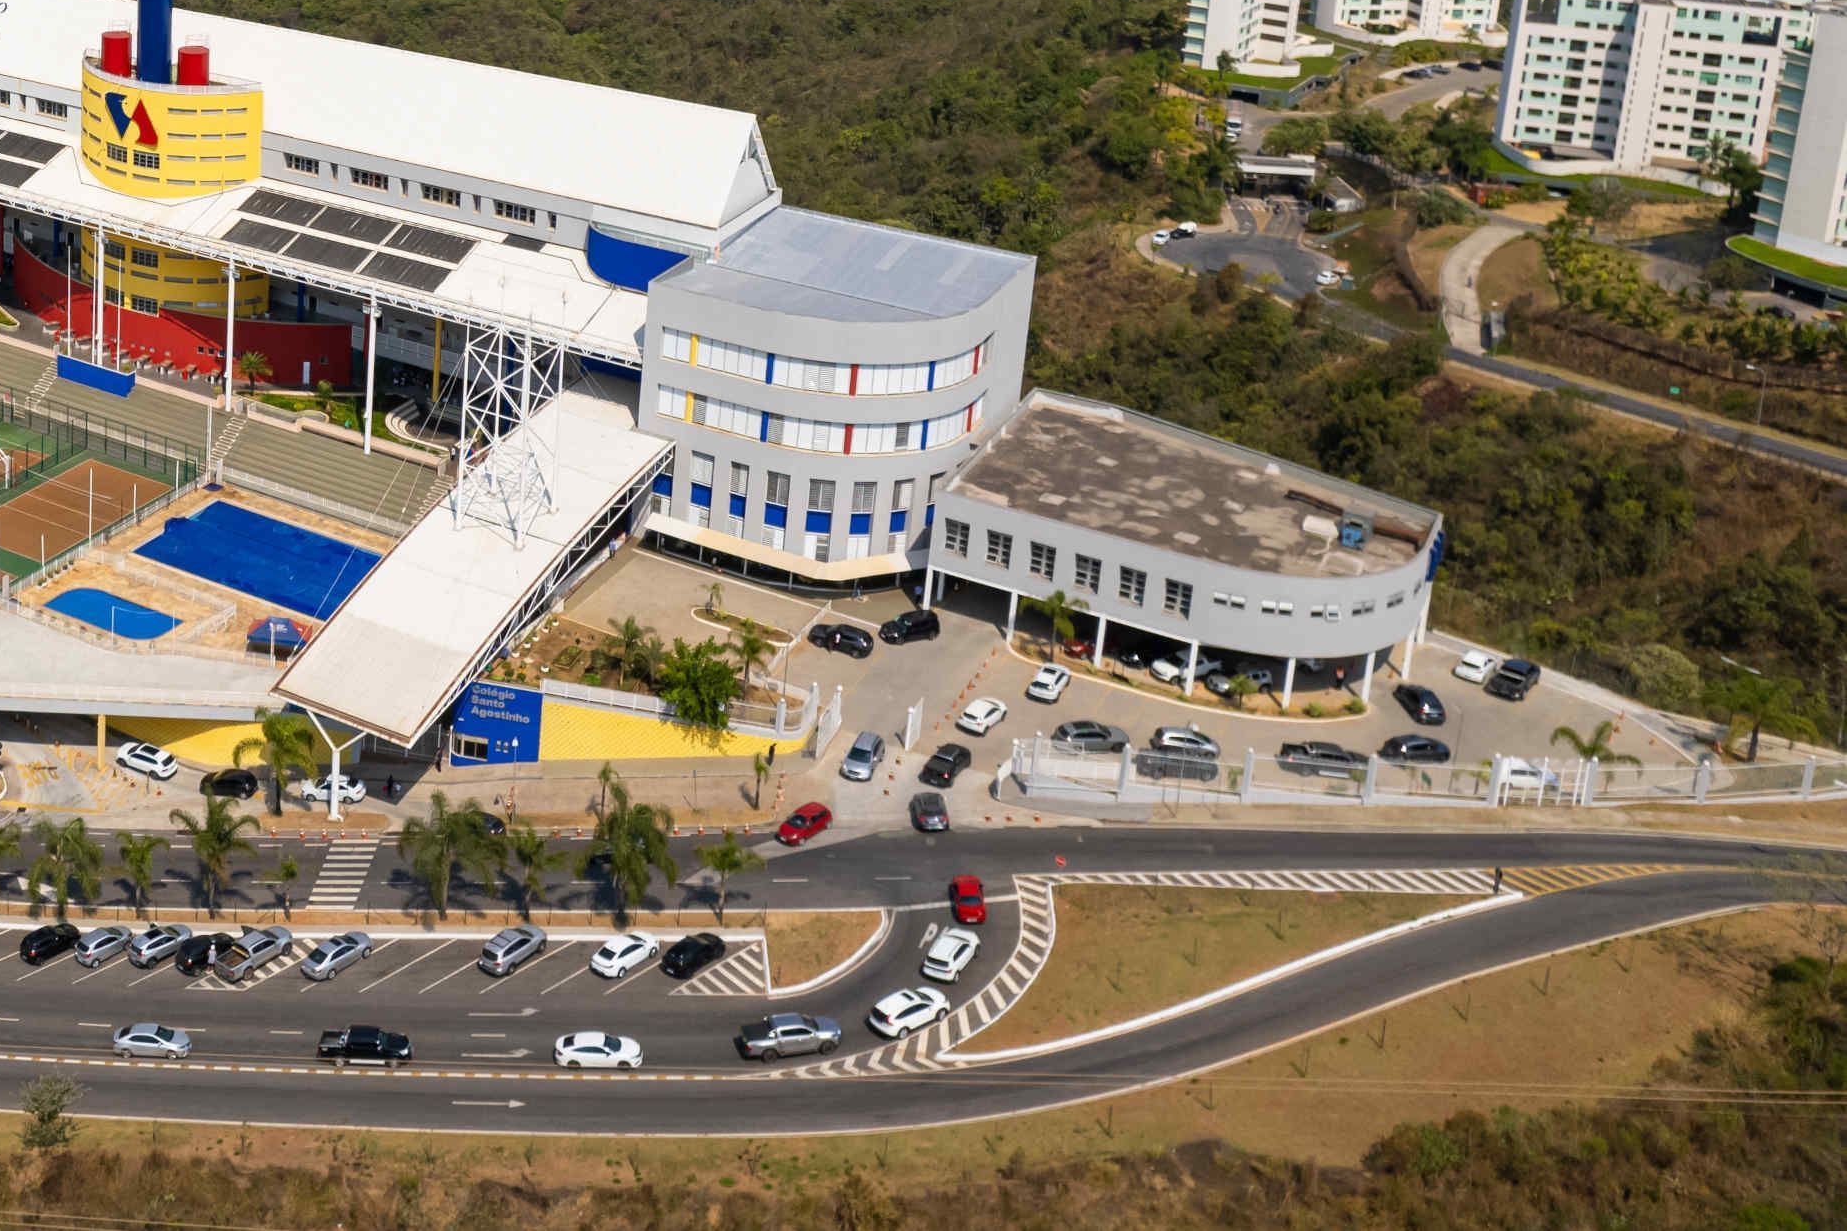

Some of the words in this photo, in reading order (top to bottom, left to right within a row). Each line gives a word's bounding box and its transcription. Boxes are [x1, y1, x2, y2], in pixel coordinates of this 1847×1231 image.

[472, 685, 515, 700] Colégio
[471, 695, 505, 708] Santo
[471, 706, 530, 724] Agostinho
